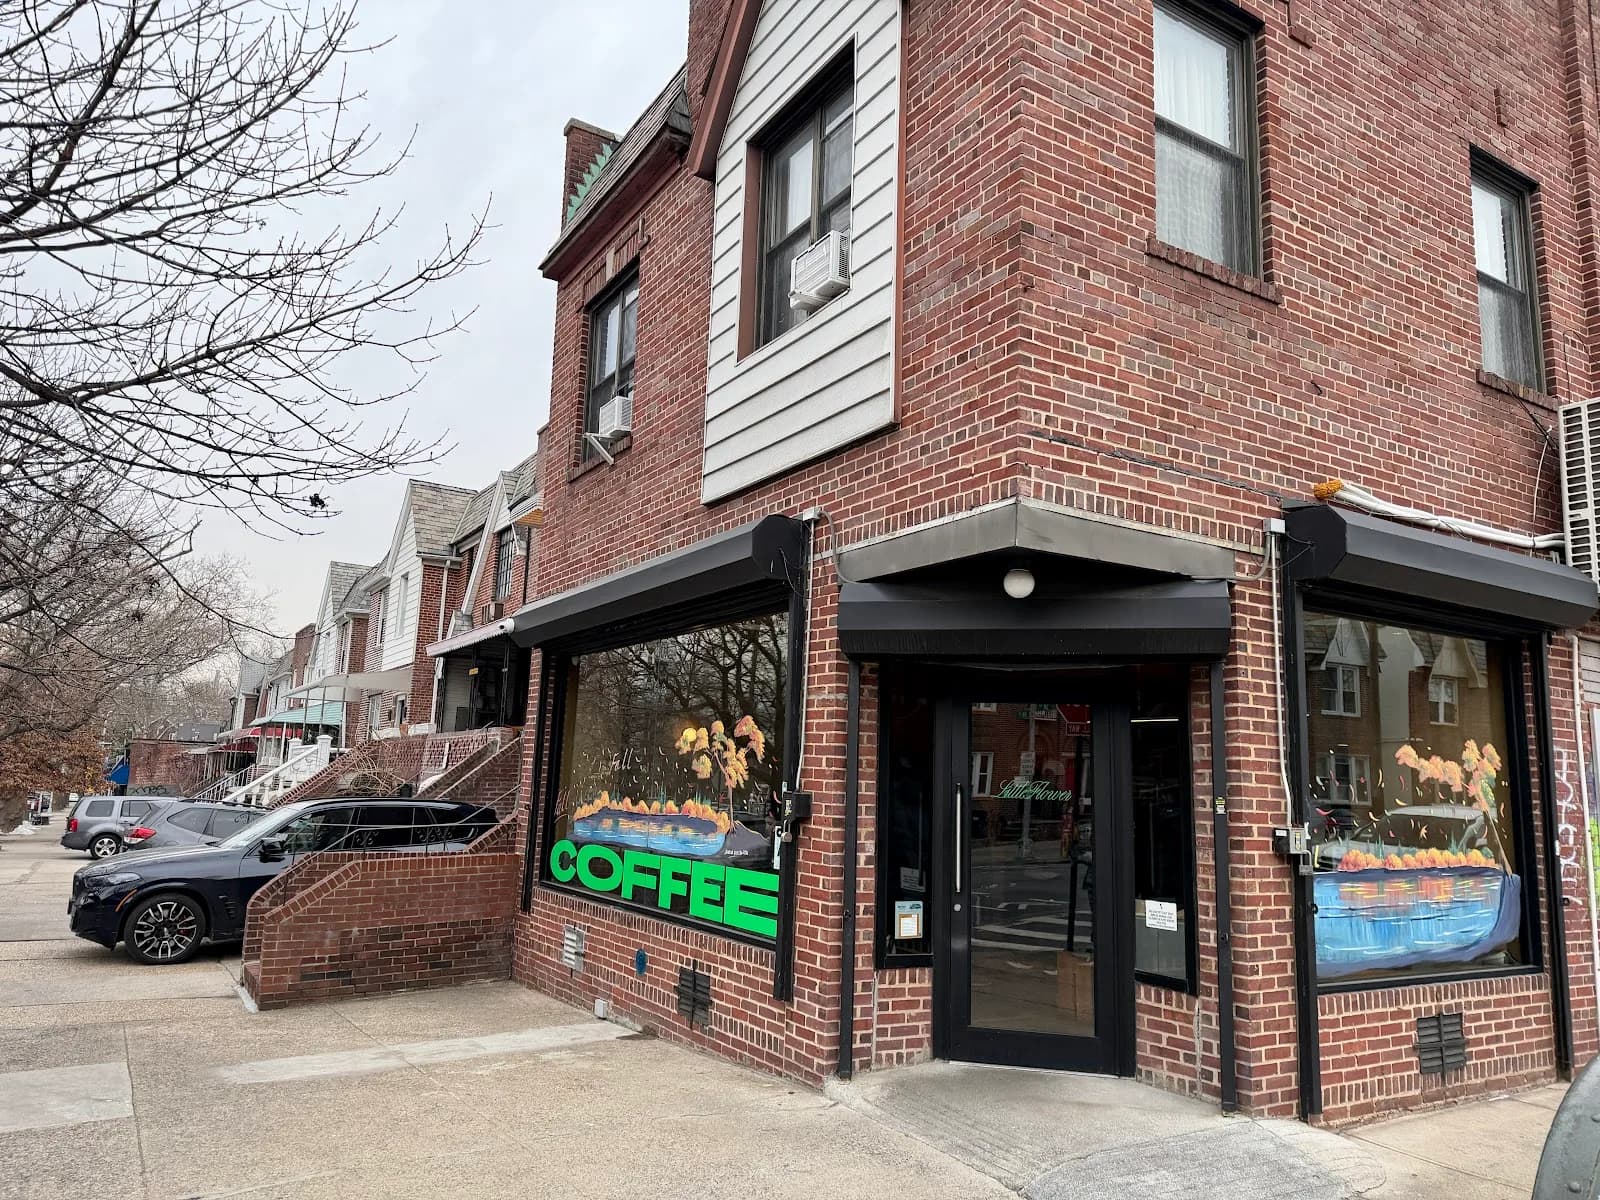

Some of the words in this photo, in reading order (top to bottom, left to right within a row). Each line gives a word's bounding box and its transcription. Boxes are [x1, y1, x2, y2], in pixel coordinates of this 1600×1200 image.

[991, 779, 1033, 800] Little
[1030, 780, 1072, 801] Flower
[550, 839, 779, 937] COFFEE
